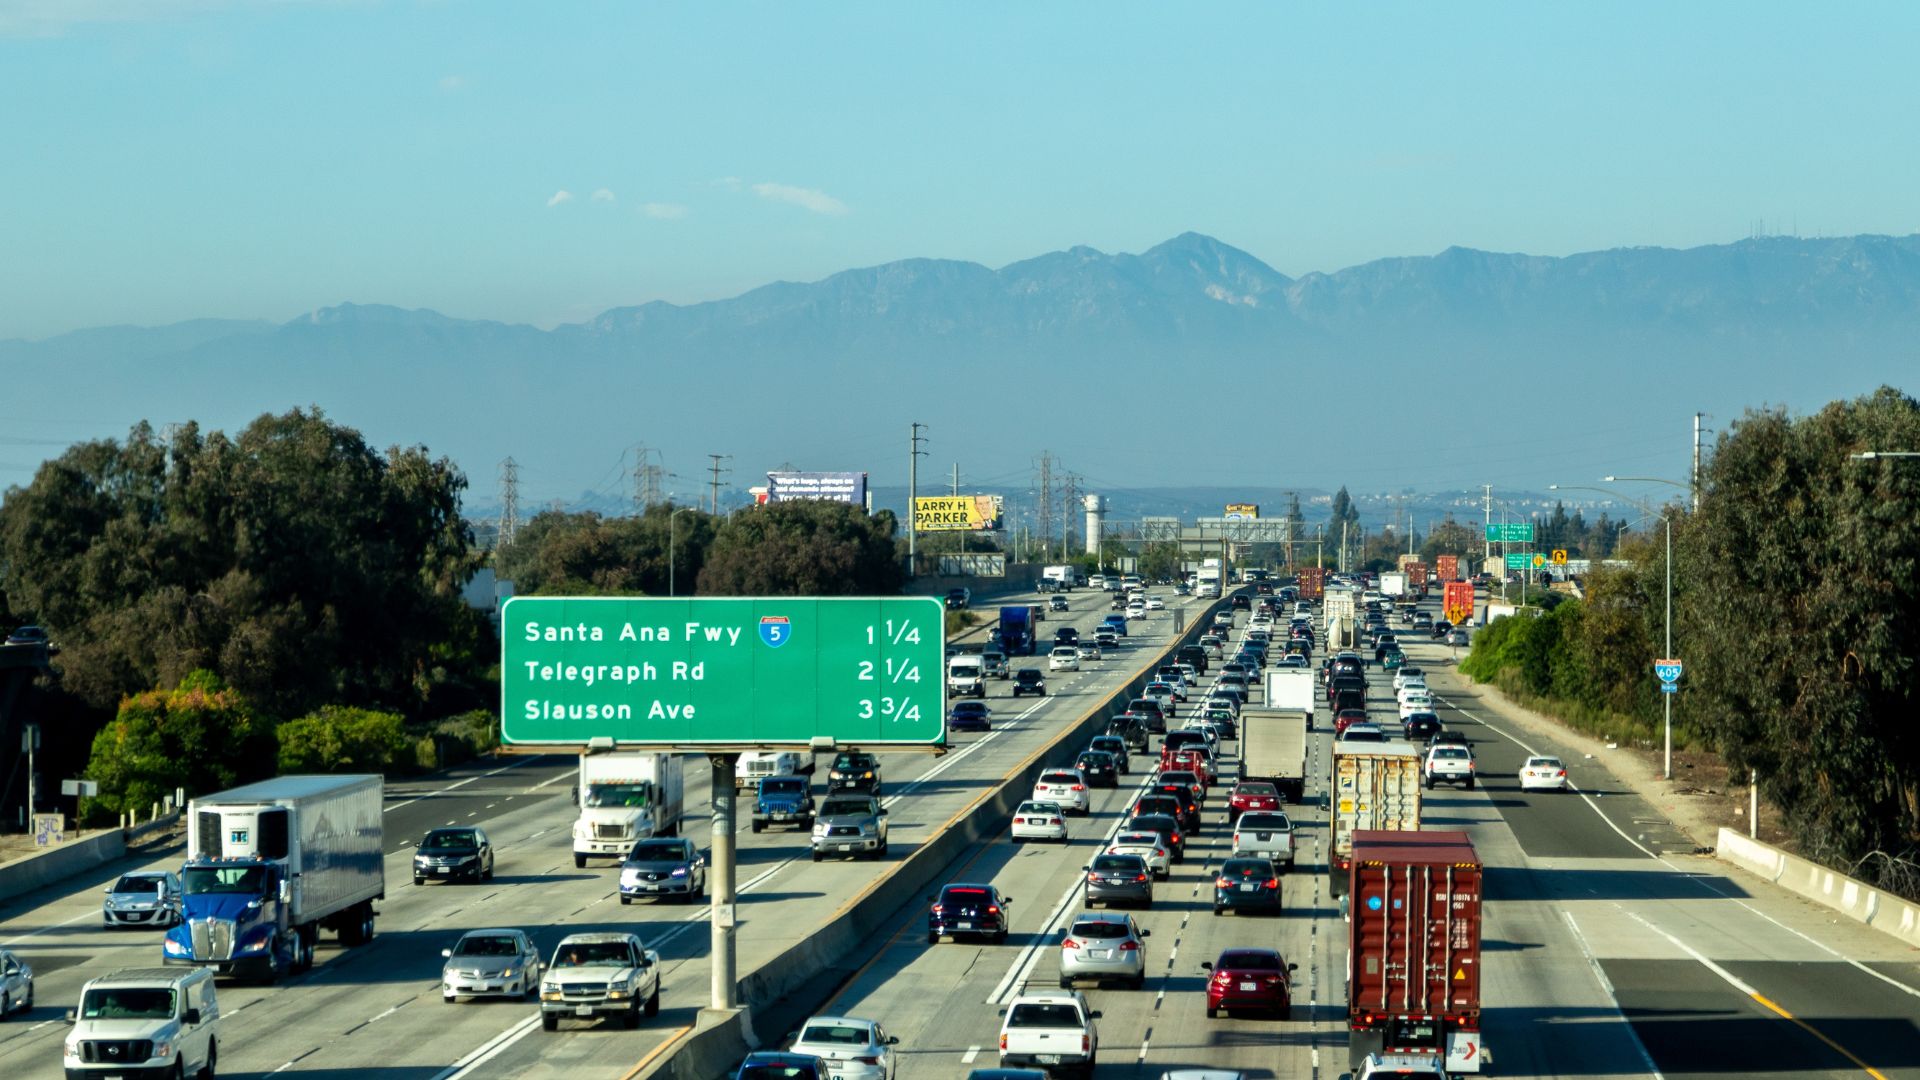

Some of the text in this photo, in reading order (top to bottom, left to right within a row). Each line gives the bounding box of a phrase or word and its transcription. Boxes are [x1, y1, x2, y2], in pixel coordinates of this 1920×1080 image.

[915, 502, 953, 511] LARRY
[915, 512, 968, 523] PARKER
[526, 623, 741, 646] Santa Ana Fwy
[770, 626, 781, 641] 5
[866, 625, 874, 644] 1
[525, 661, 704, 686] Telegraph Rd
[858, 661, 874, 680] 2
[1659, 668, 1678, 677] 605
[525, 700, 696, 719] Slauson Ave
[859, 700, 873, 719] 3
